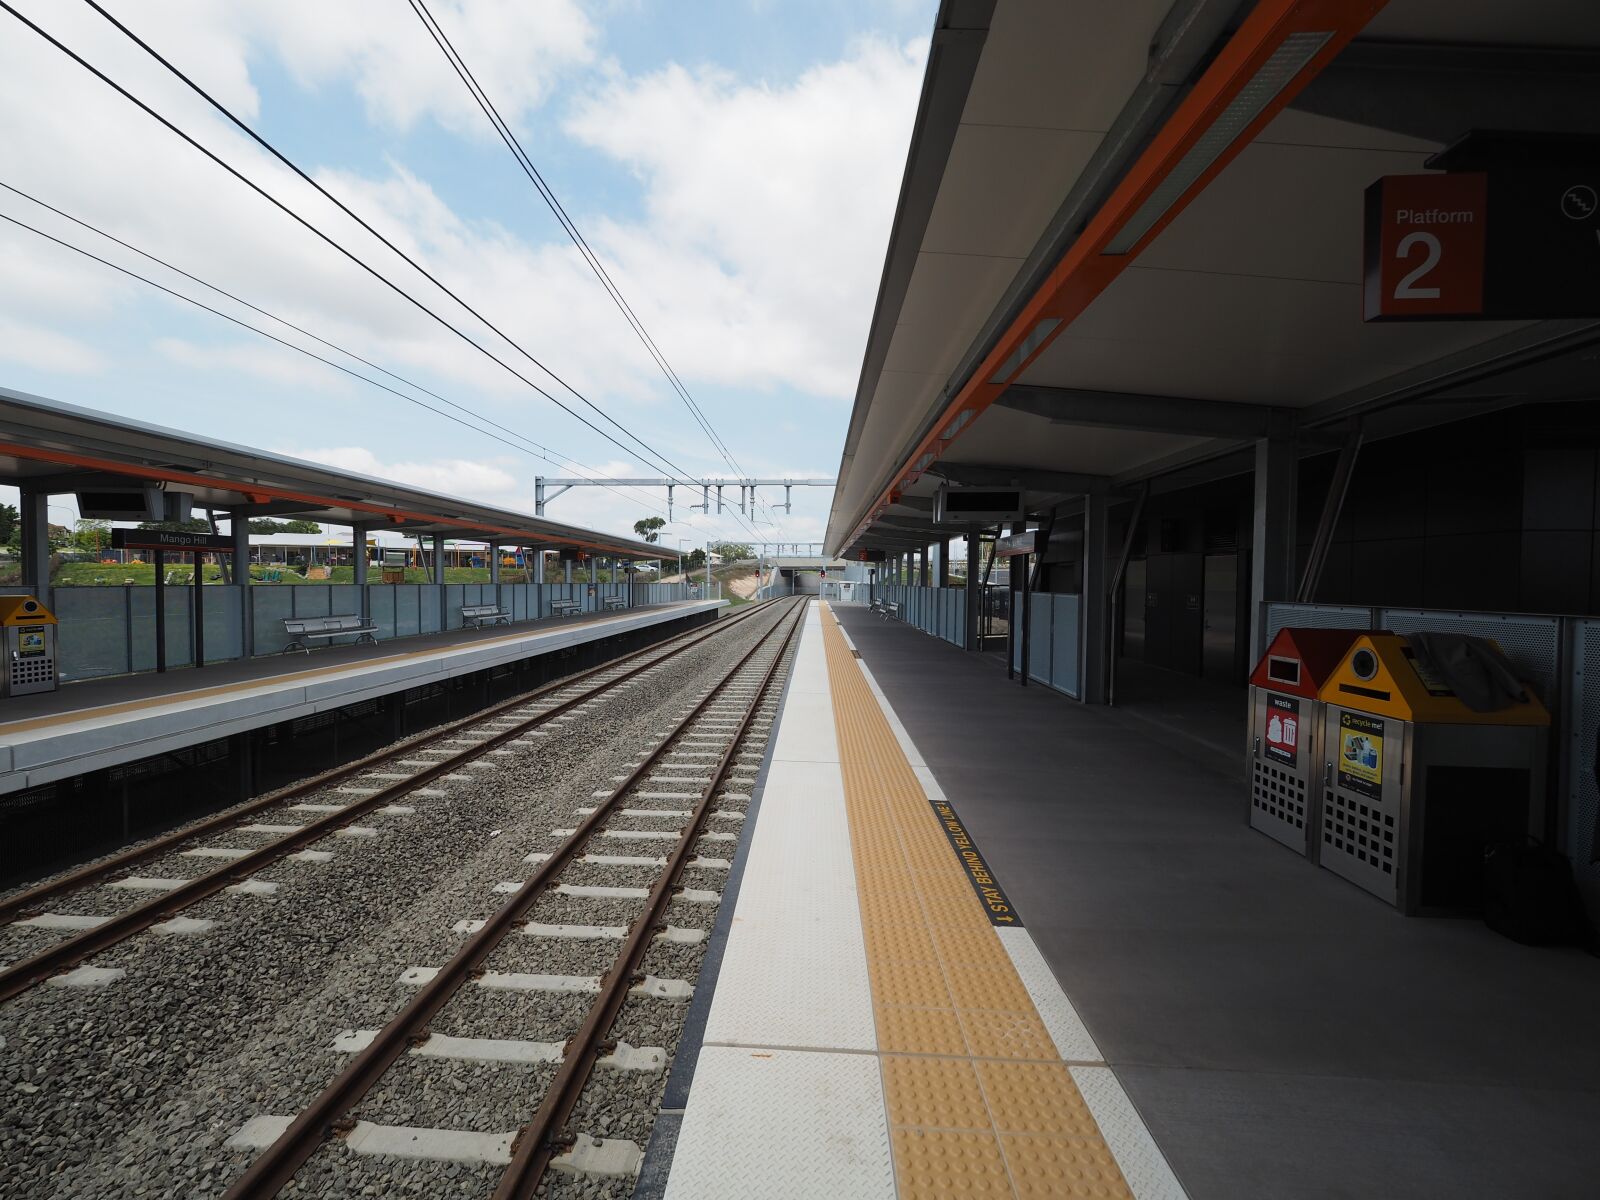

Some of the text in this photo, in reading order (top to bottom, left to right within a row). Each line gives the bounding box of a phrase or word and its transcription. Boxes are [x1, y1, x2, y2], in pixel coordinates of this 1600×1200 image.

[1396, 209, 1474, 225] Platform
[1393, 231, 1442, 300] 2
[160, 533, 207, 545] Mango Hill
[1274, 699, 1292, 709] waste
[1351, 717, 1383, 731] recycle me!
[937, 806, 1009, 913] STAY BEHIND YELLOW LINE
